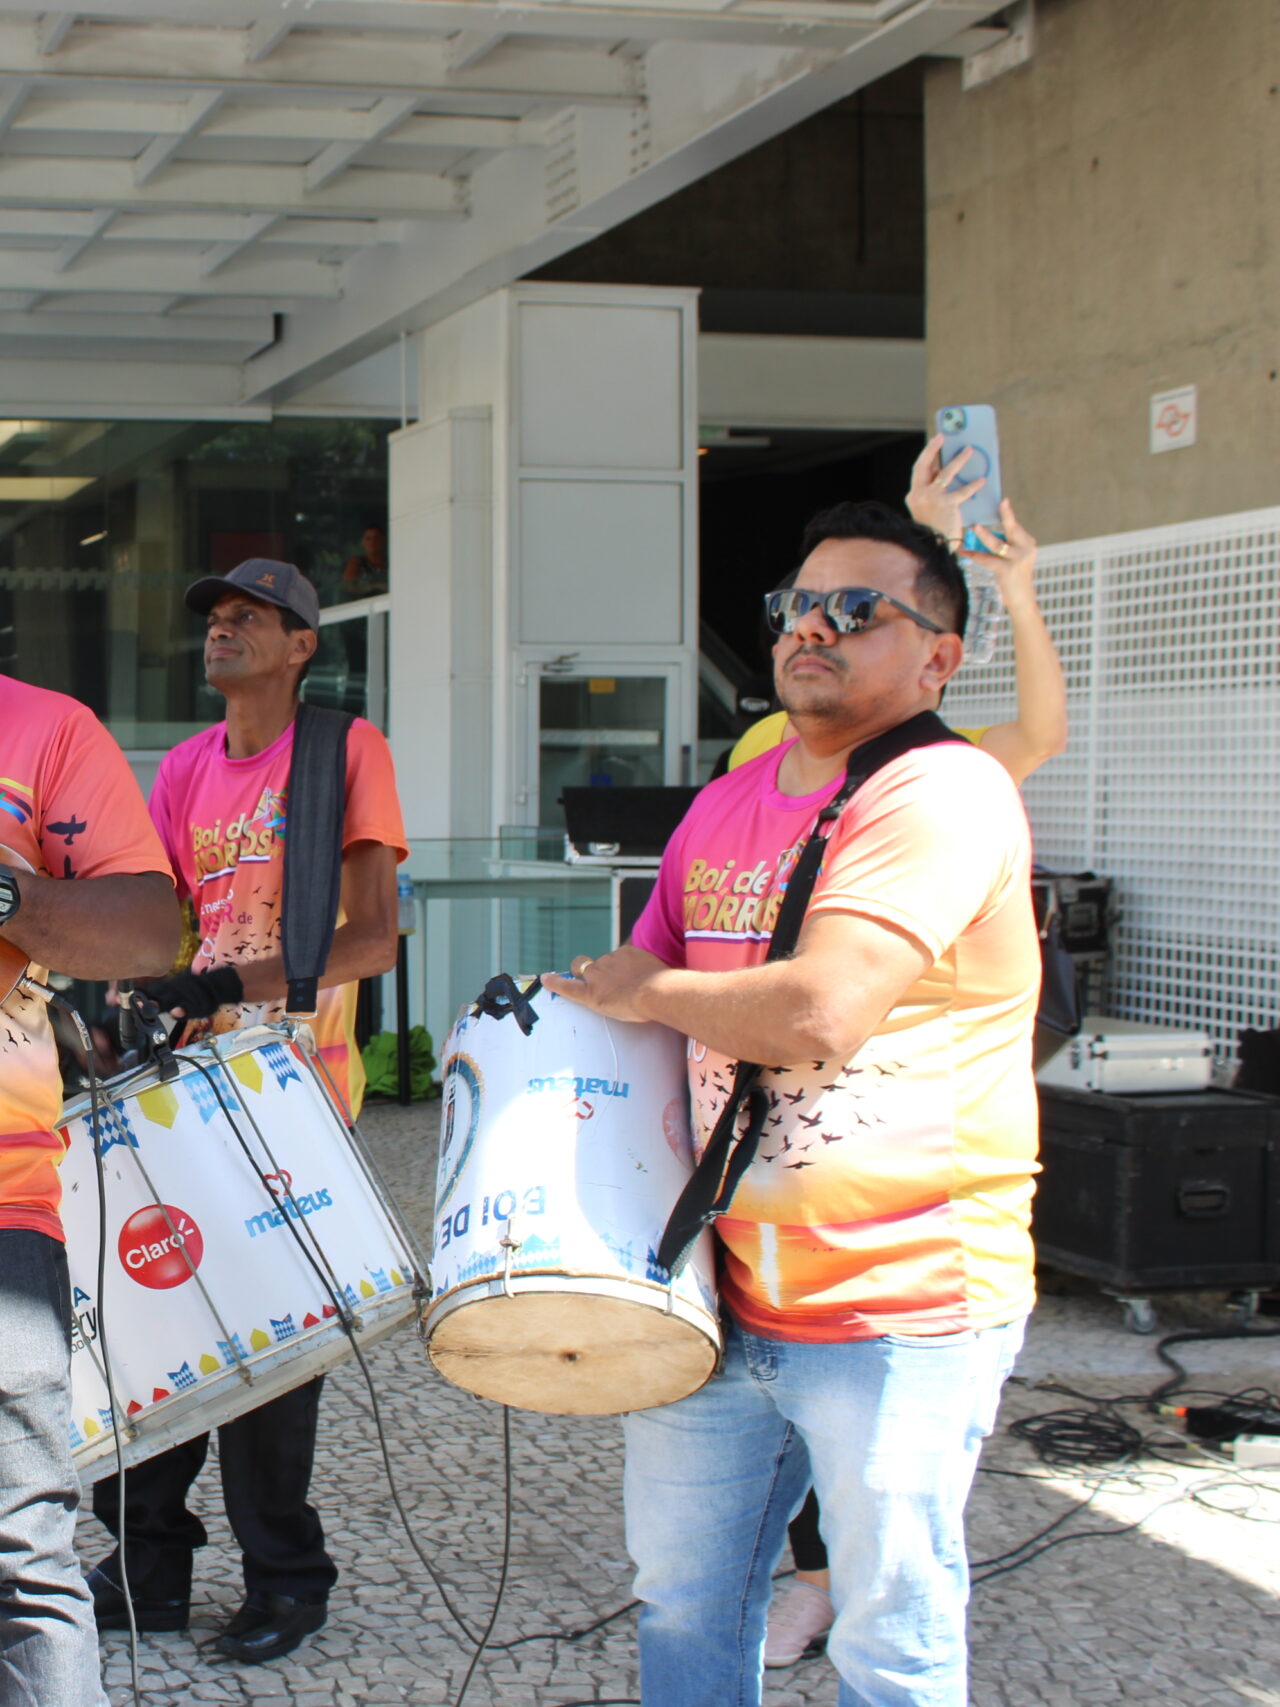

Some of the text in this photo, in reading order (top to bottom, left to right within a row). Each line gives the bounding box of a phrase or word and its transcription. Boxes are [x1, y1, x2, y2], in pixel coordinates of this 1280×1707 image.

[684, 859, 771, 895] Boi de
[236, 911, 253, 925] de
[244, 1188, 333, 1238] mateus
[125, 1233, 186, 1269] Claro
